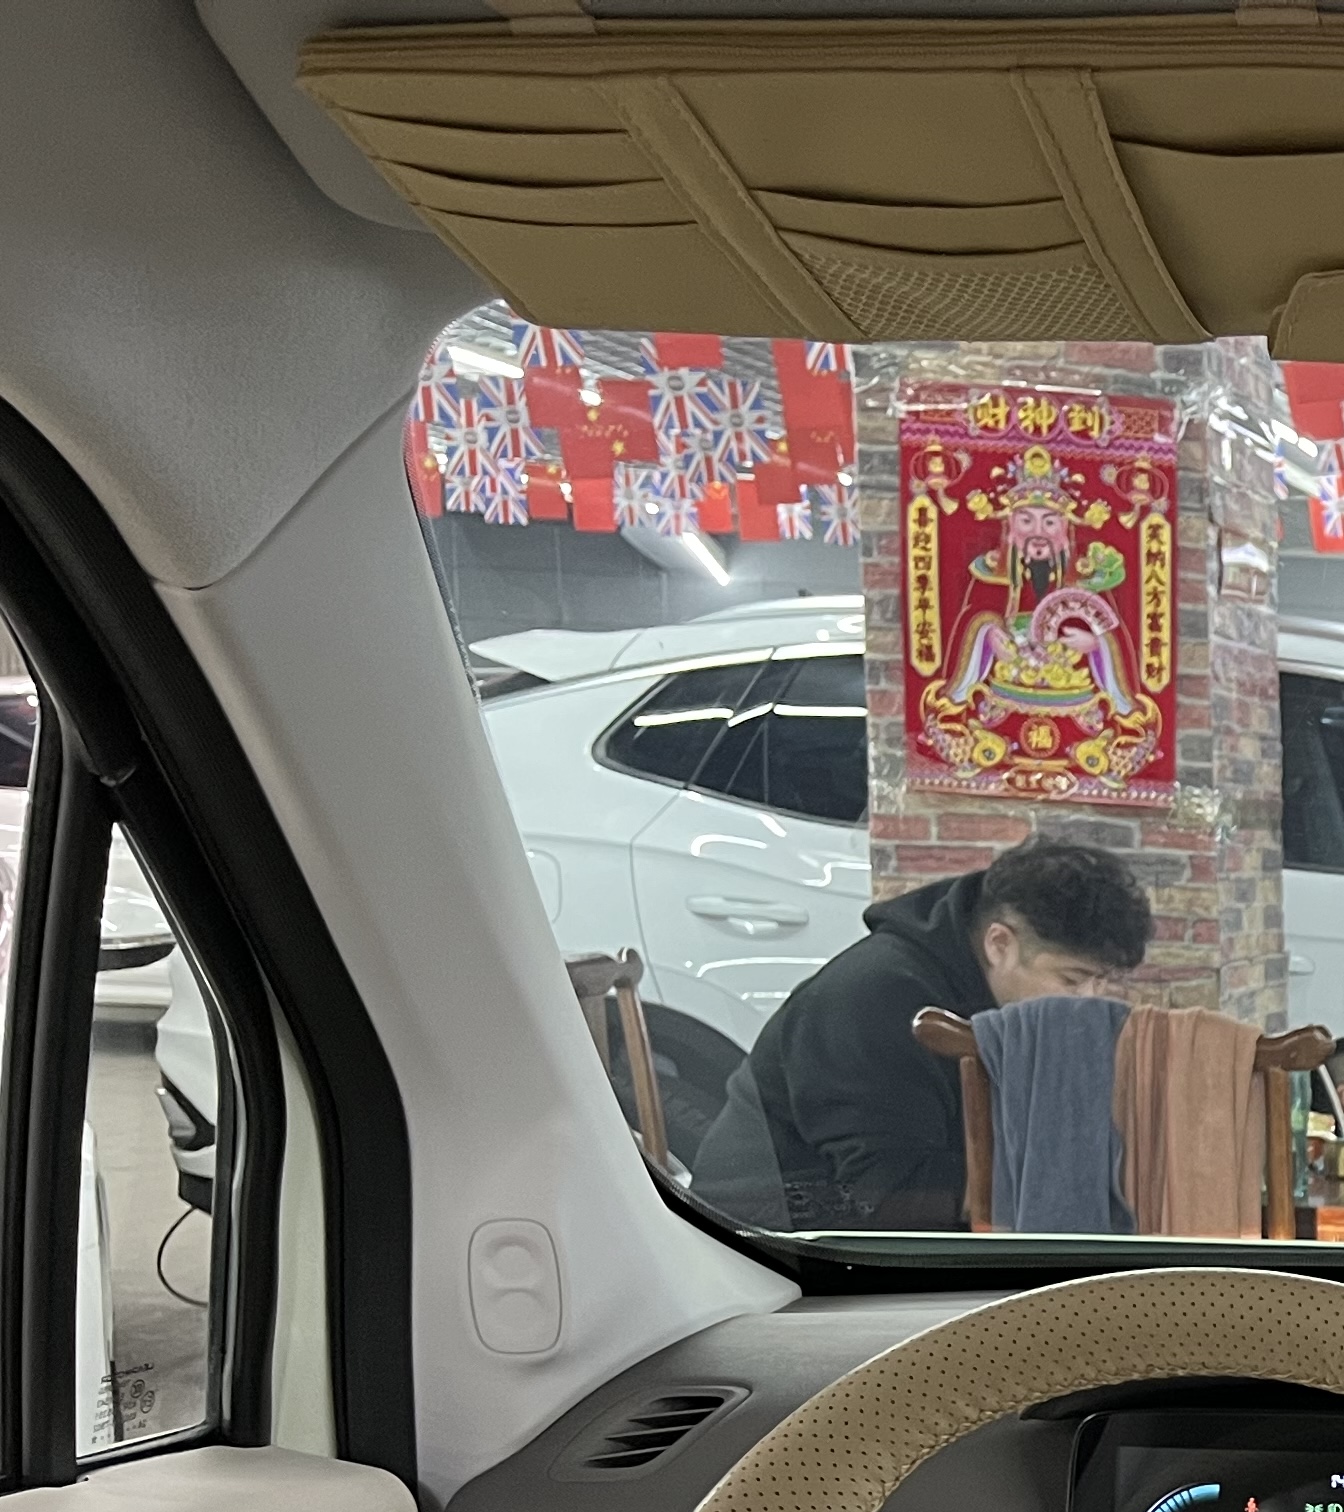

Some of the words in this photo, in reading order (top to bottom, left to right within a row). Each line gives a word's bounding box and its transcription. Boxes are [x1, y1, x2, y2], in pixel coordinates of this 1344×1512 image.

[974, 397, 1102, 439] 财神到
[1027, 724, 1053, 749] 福
